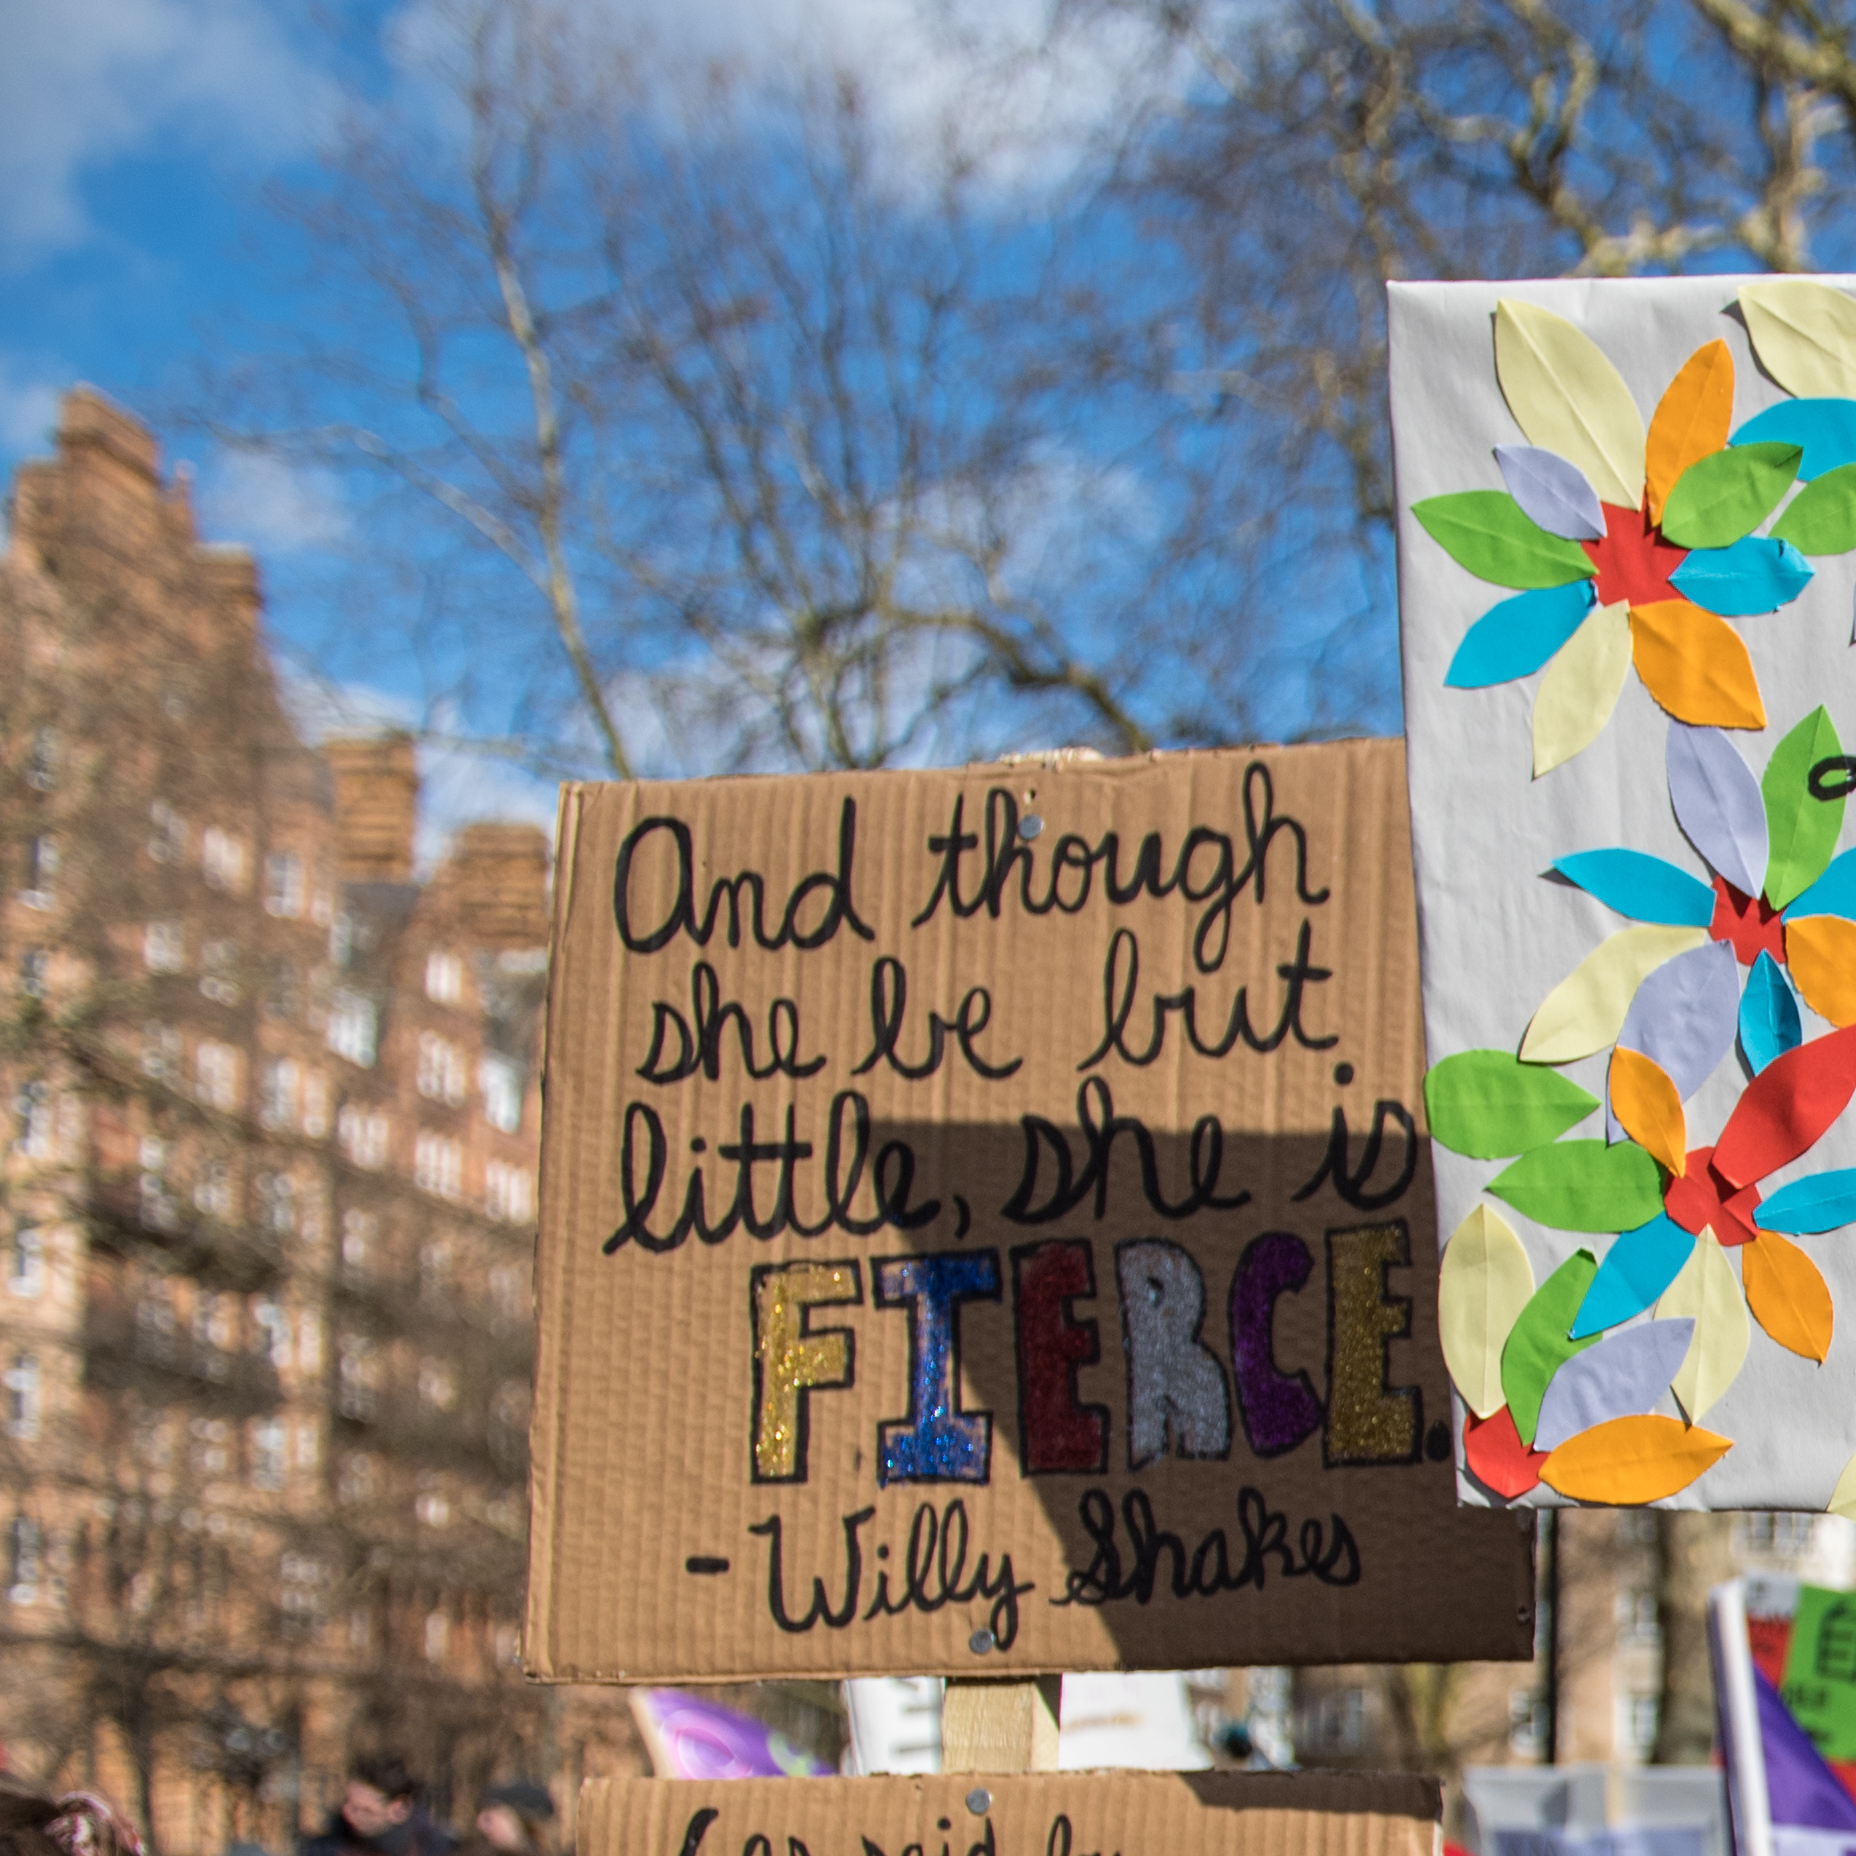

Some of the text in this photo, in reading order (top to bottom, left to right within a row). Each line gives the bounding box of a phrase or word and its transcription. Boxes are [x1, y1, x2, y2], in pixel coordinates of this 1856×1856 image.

[614, 762, 1330, 973] And though
[637, 920, 1339, 1085] she be but
[603, 1062, 1422, 1255] little, she is
[747, 1217, 1452, 1488] FIERCE.
[1049, 1487, 1361, 1608] Shakes
